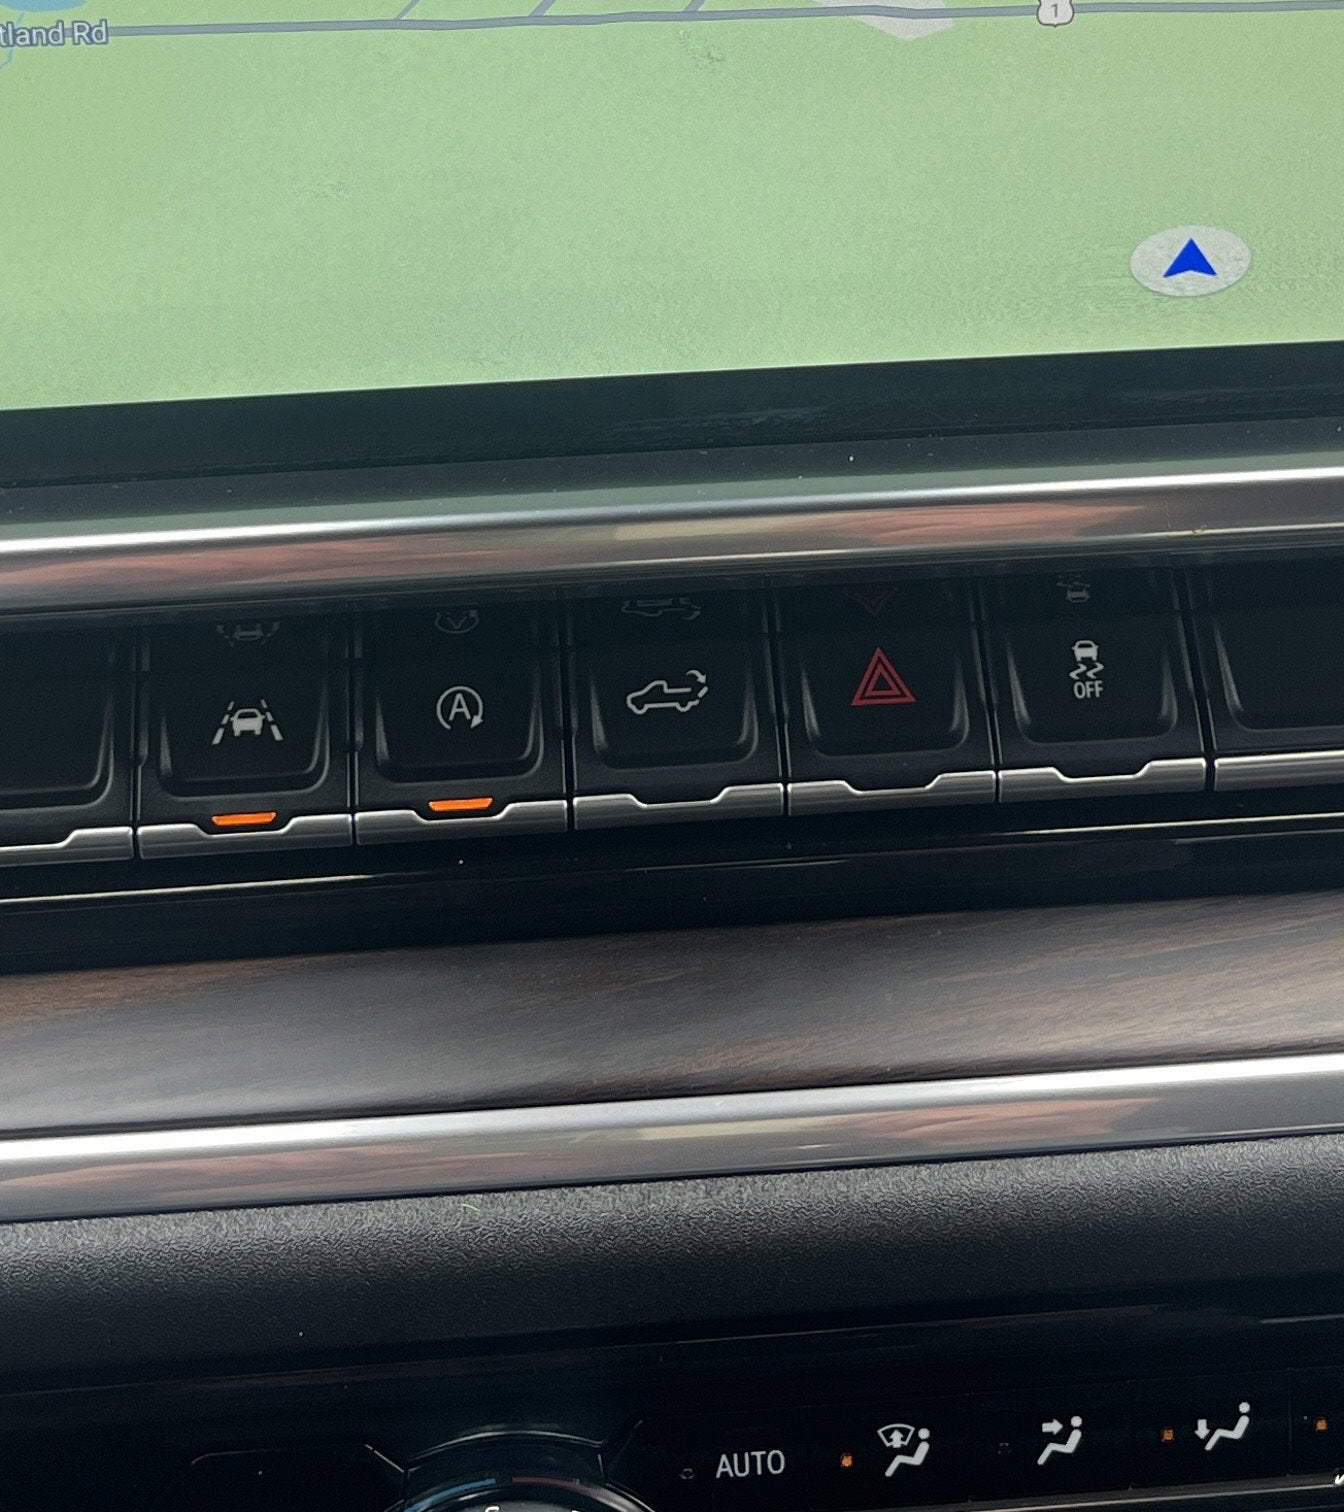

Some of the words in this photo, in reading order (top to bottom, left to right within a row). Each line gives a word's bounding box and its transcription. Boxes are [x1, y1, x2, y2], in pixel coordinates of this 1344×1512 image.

[72, 19, 108, 46] Rd
[1072, 681, 1104, 700] OFF
[715, 1449, 786, 1479] AUTO
